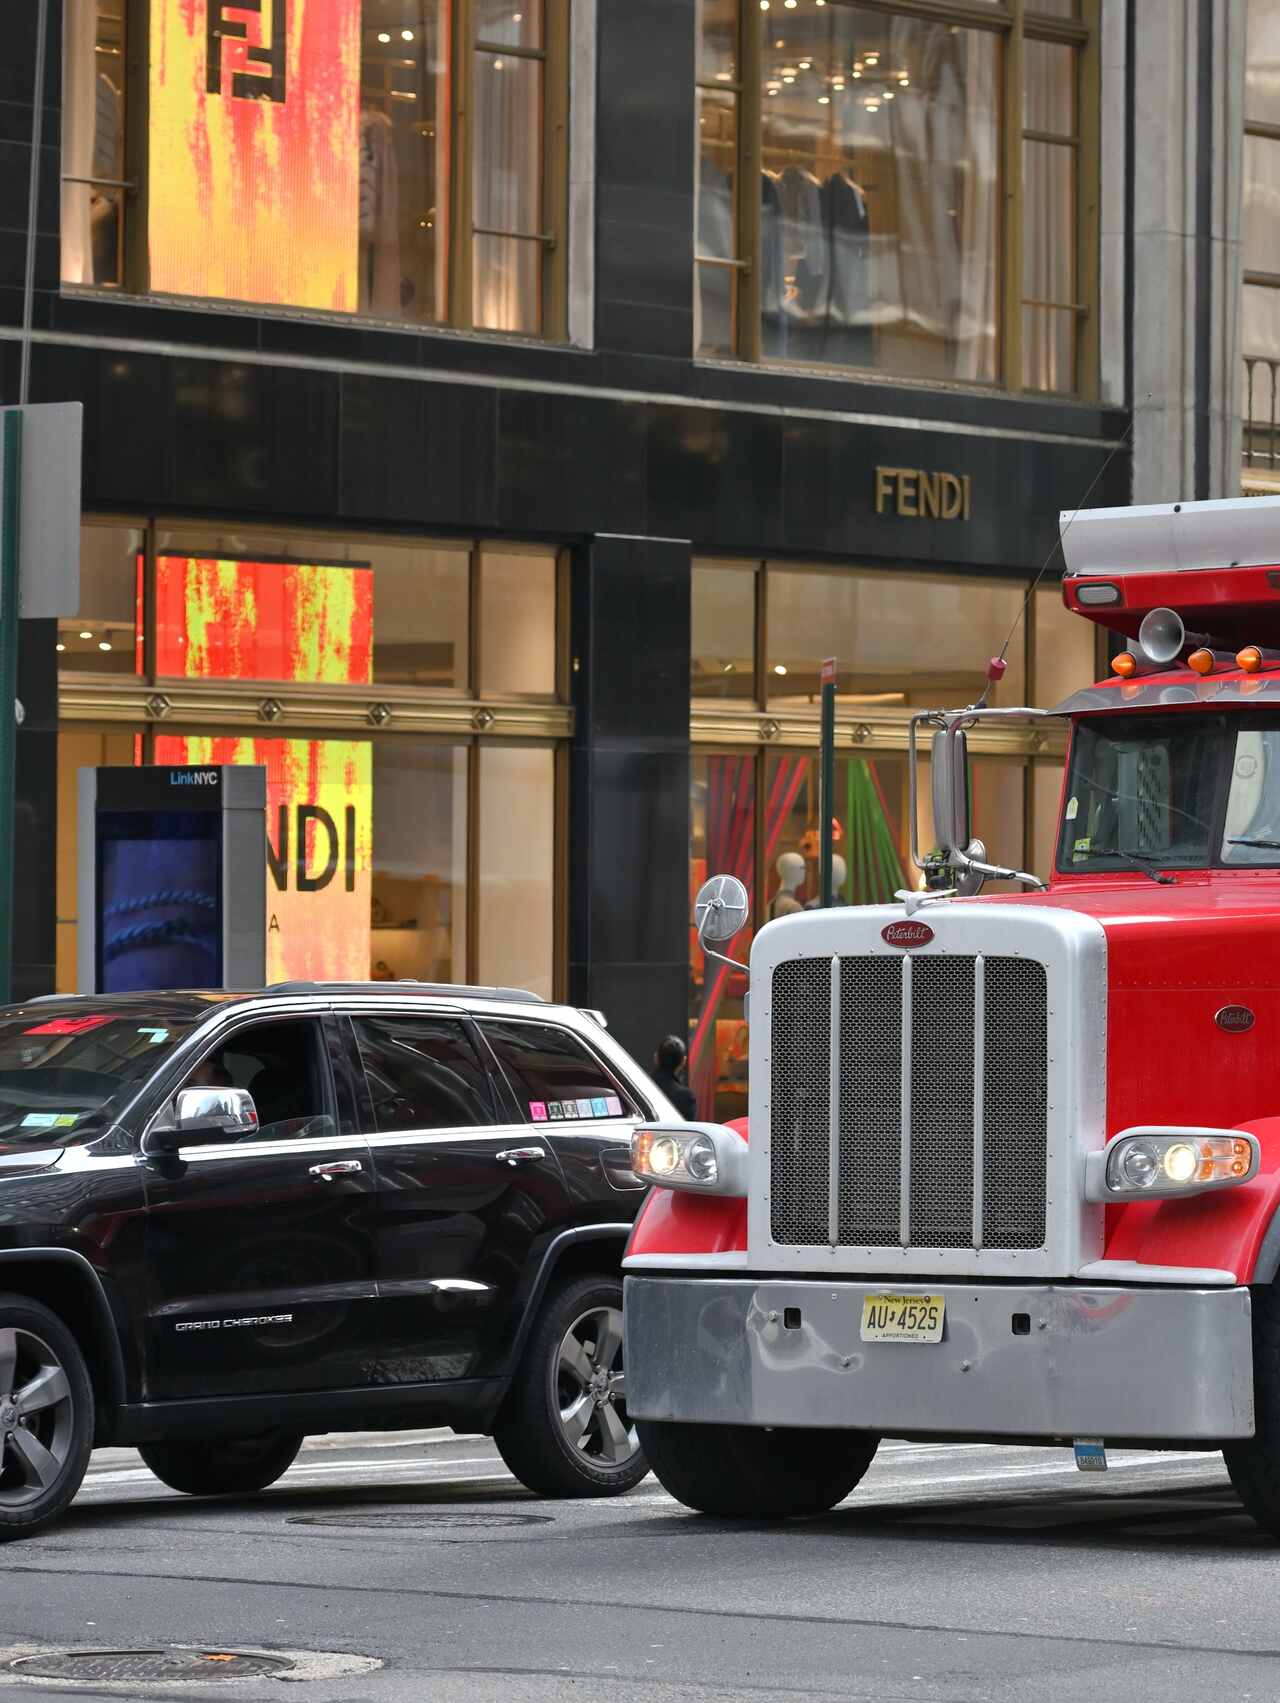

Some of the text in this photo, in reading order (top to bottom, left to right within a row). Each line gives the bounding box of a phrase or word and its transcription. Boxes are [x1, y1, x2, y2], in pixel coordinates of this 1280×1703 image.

[875, 466, 971, 520] FENDI
[170, 771, 218, 785] LinkNYC
[887, 925, 929, 941] Peterbilt
[883, 1295, 924, 1305] New Jersey
[176, 1314, 292, 1331] GRAND CHEROKEE
[867, 1306, 888, 1328] AU
